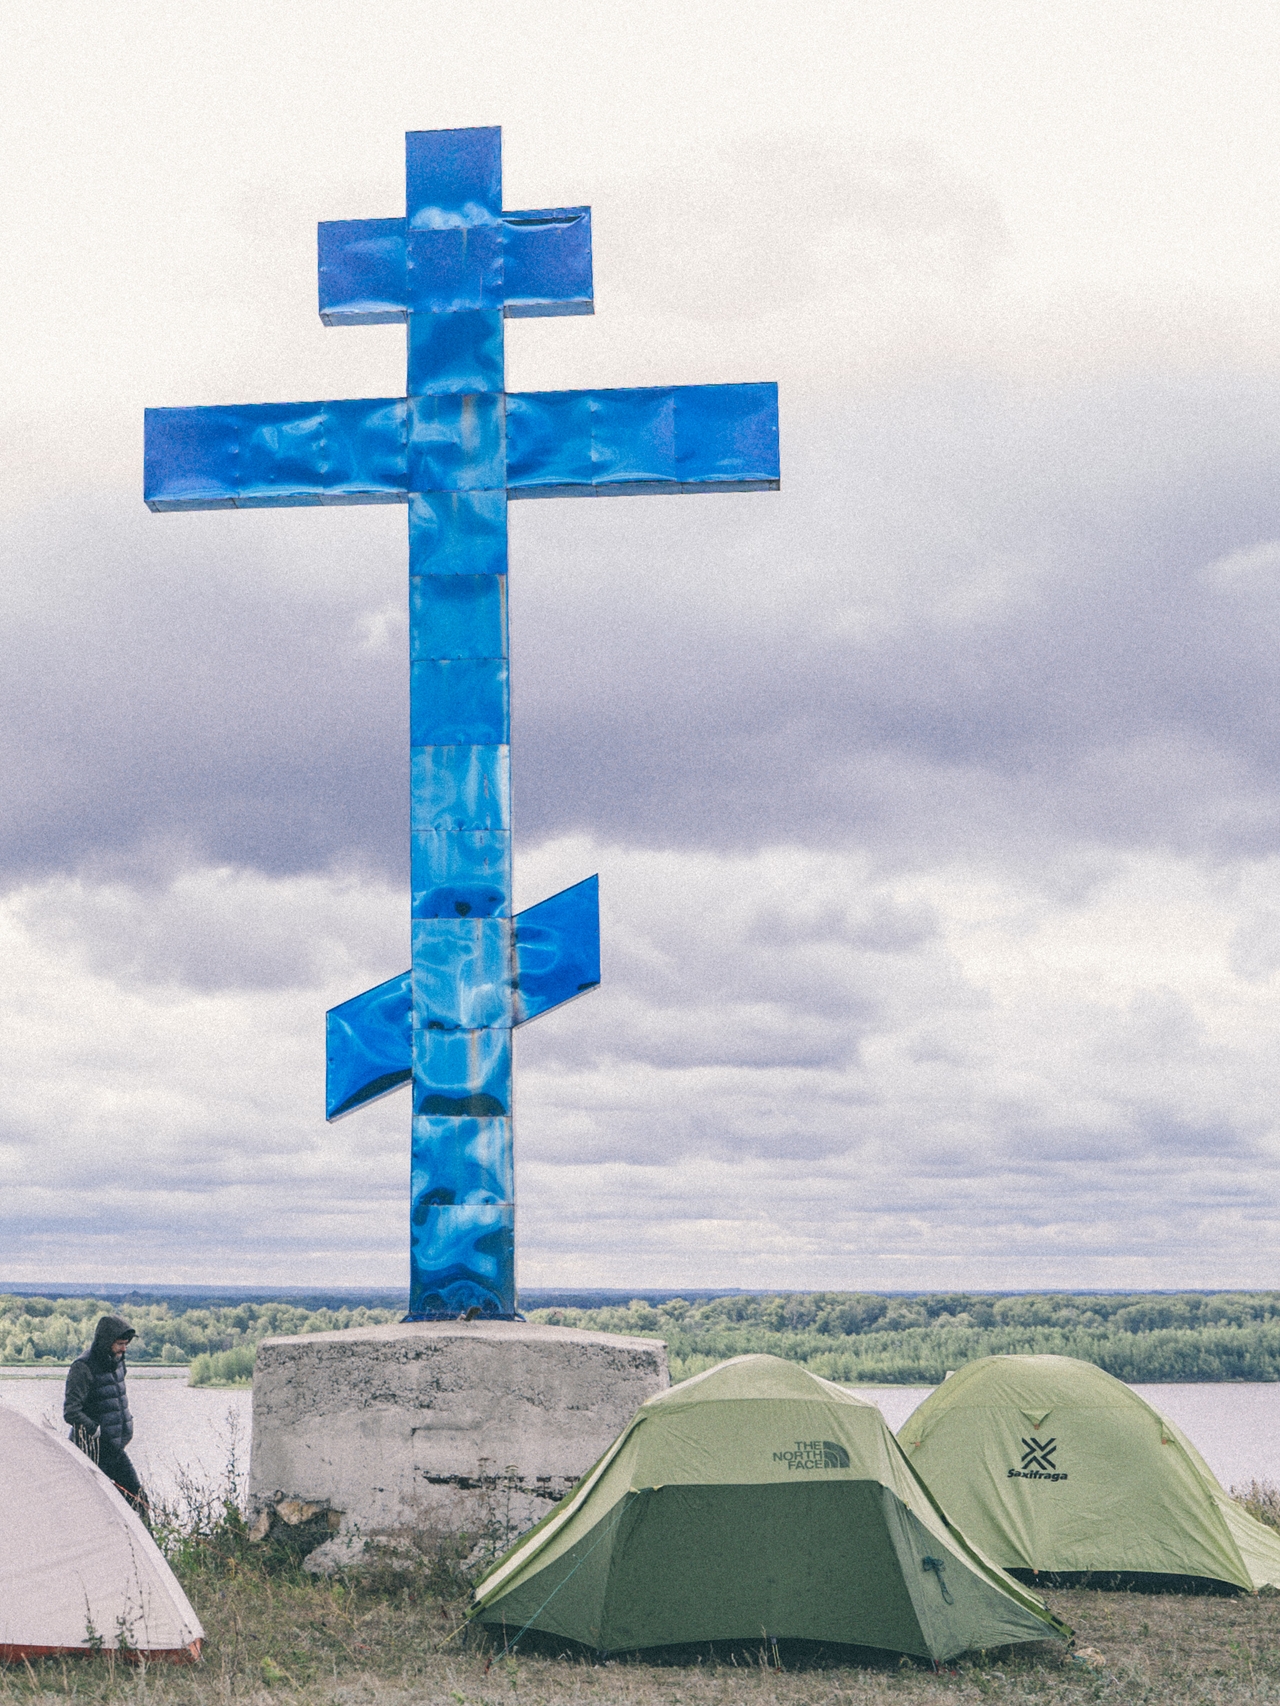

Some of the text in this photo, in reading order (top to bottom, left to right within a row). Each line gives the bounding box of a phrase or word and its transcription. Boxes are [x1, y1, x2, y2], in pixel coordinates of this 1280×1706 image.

[794, 1441, 822, 1451] THE
[772, 1450, 822, 1462] NORTH
[787, 1460, 823, 1470] FACE
[1007, 1468, 1068, 1482] Saxifraga
